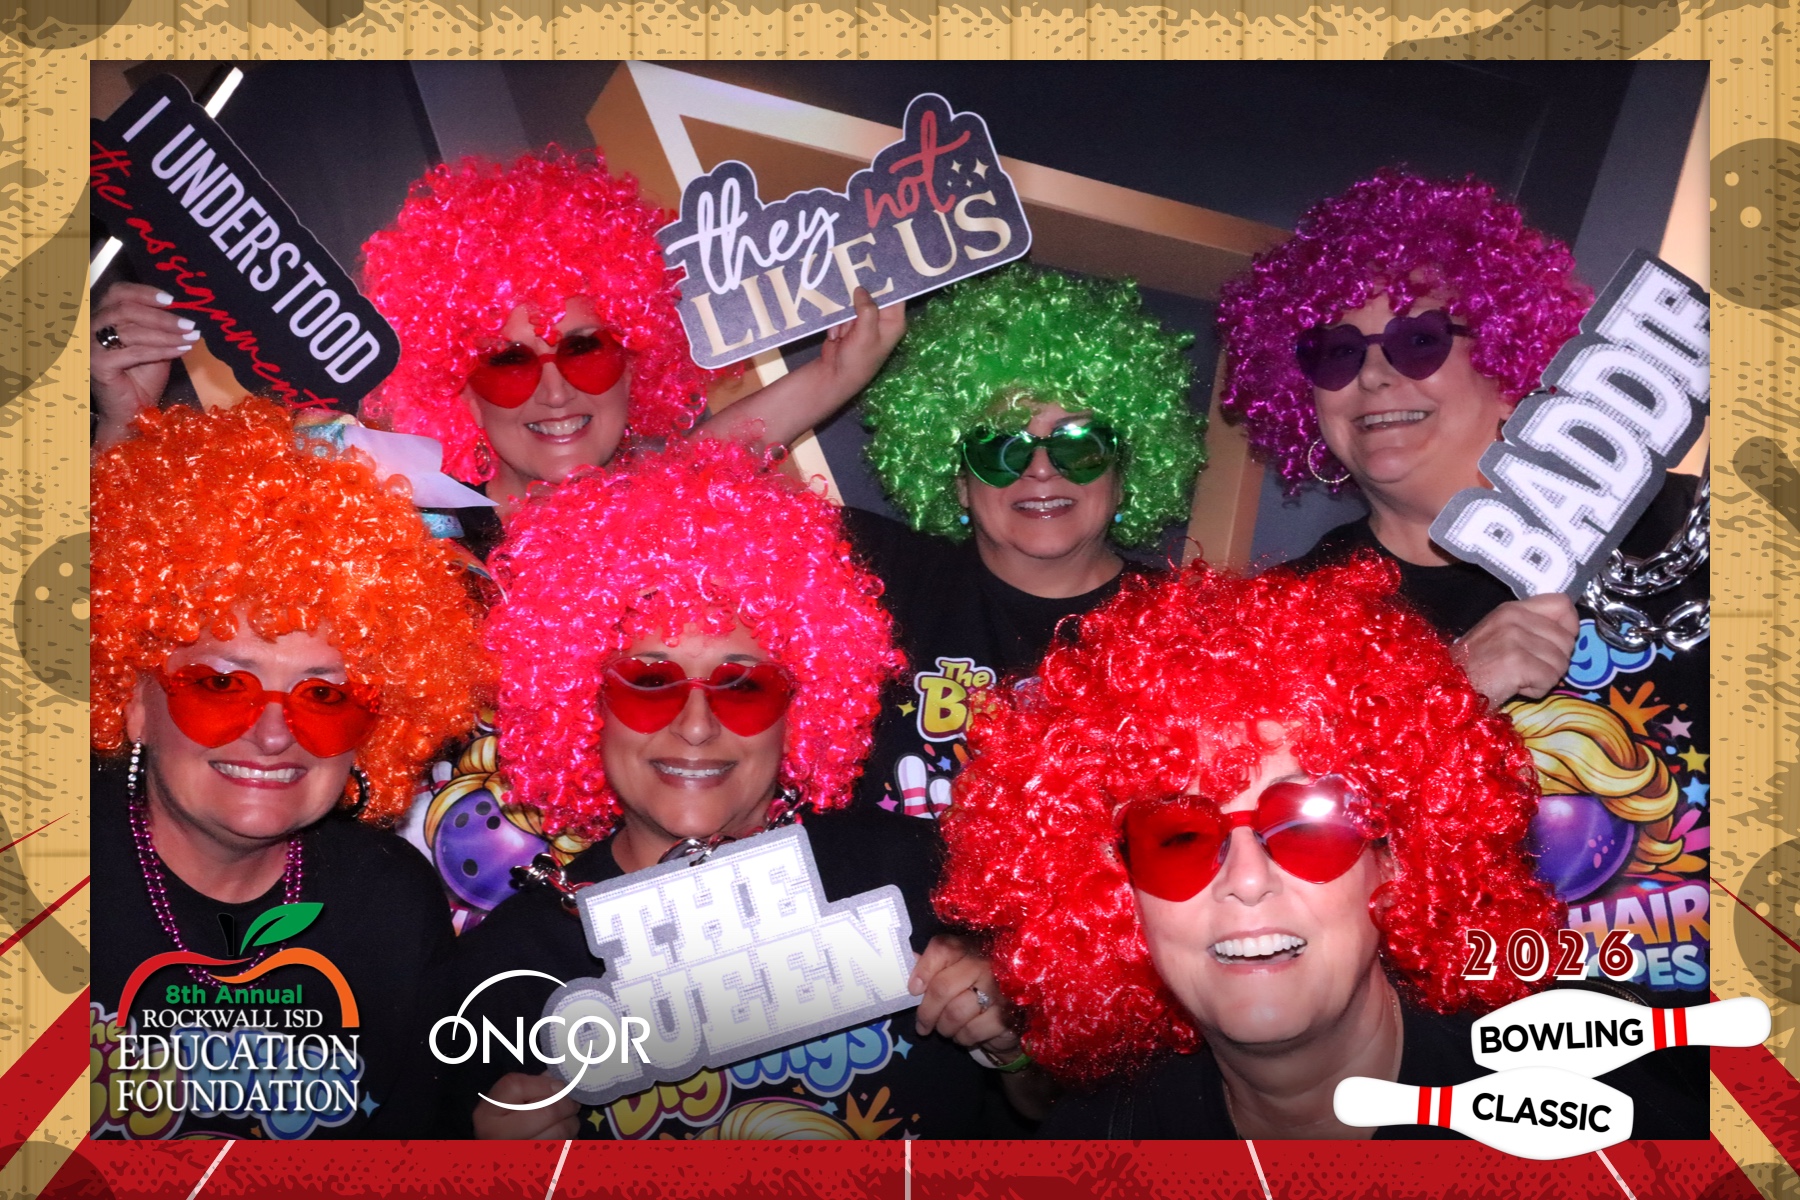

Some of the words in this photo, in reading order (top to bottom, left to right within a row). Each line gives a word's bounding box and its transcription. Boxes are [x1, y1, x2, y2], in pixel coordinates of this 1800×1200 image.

[90, 140, 133, 210] the
[126, 217, 340, 411] assignment
[122, 95, 171, 143] I
[152, 123, 380, 383] UNDERSTOOD
[665, 177, 840, 295] they
[864, 110, 972, 228] not
[690, 232, 894, 358] LIKE
[893, 190, 1012, 278] US
[1444, 260, 1710, 596] BADDIE
[940, 660, 991, 688] The
[586, 835, 820, 981] THE
[1568, 884, 1710, 948] HAIR
[1587, 944, 1707, 985] PES
[90, 1006, 128, 1045] he
[549, 897, 912, 1093] QUEEN
